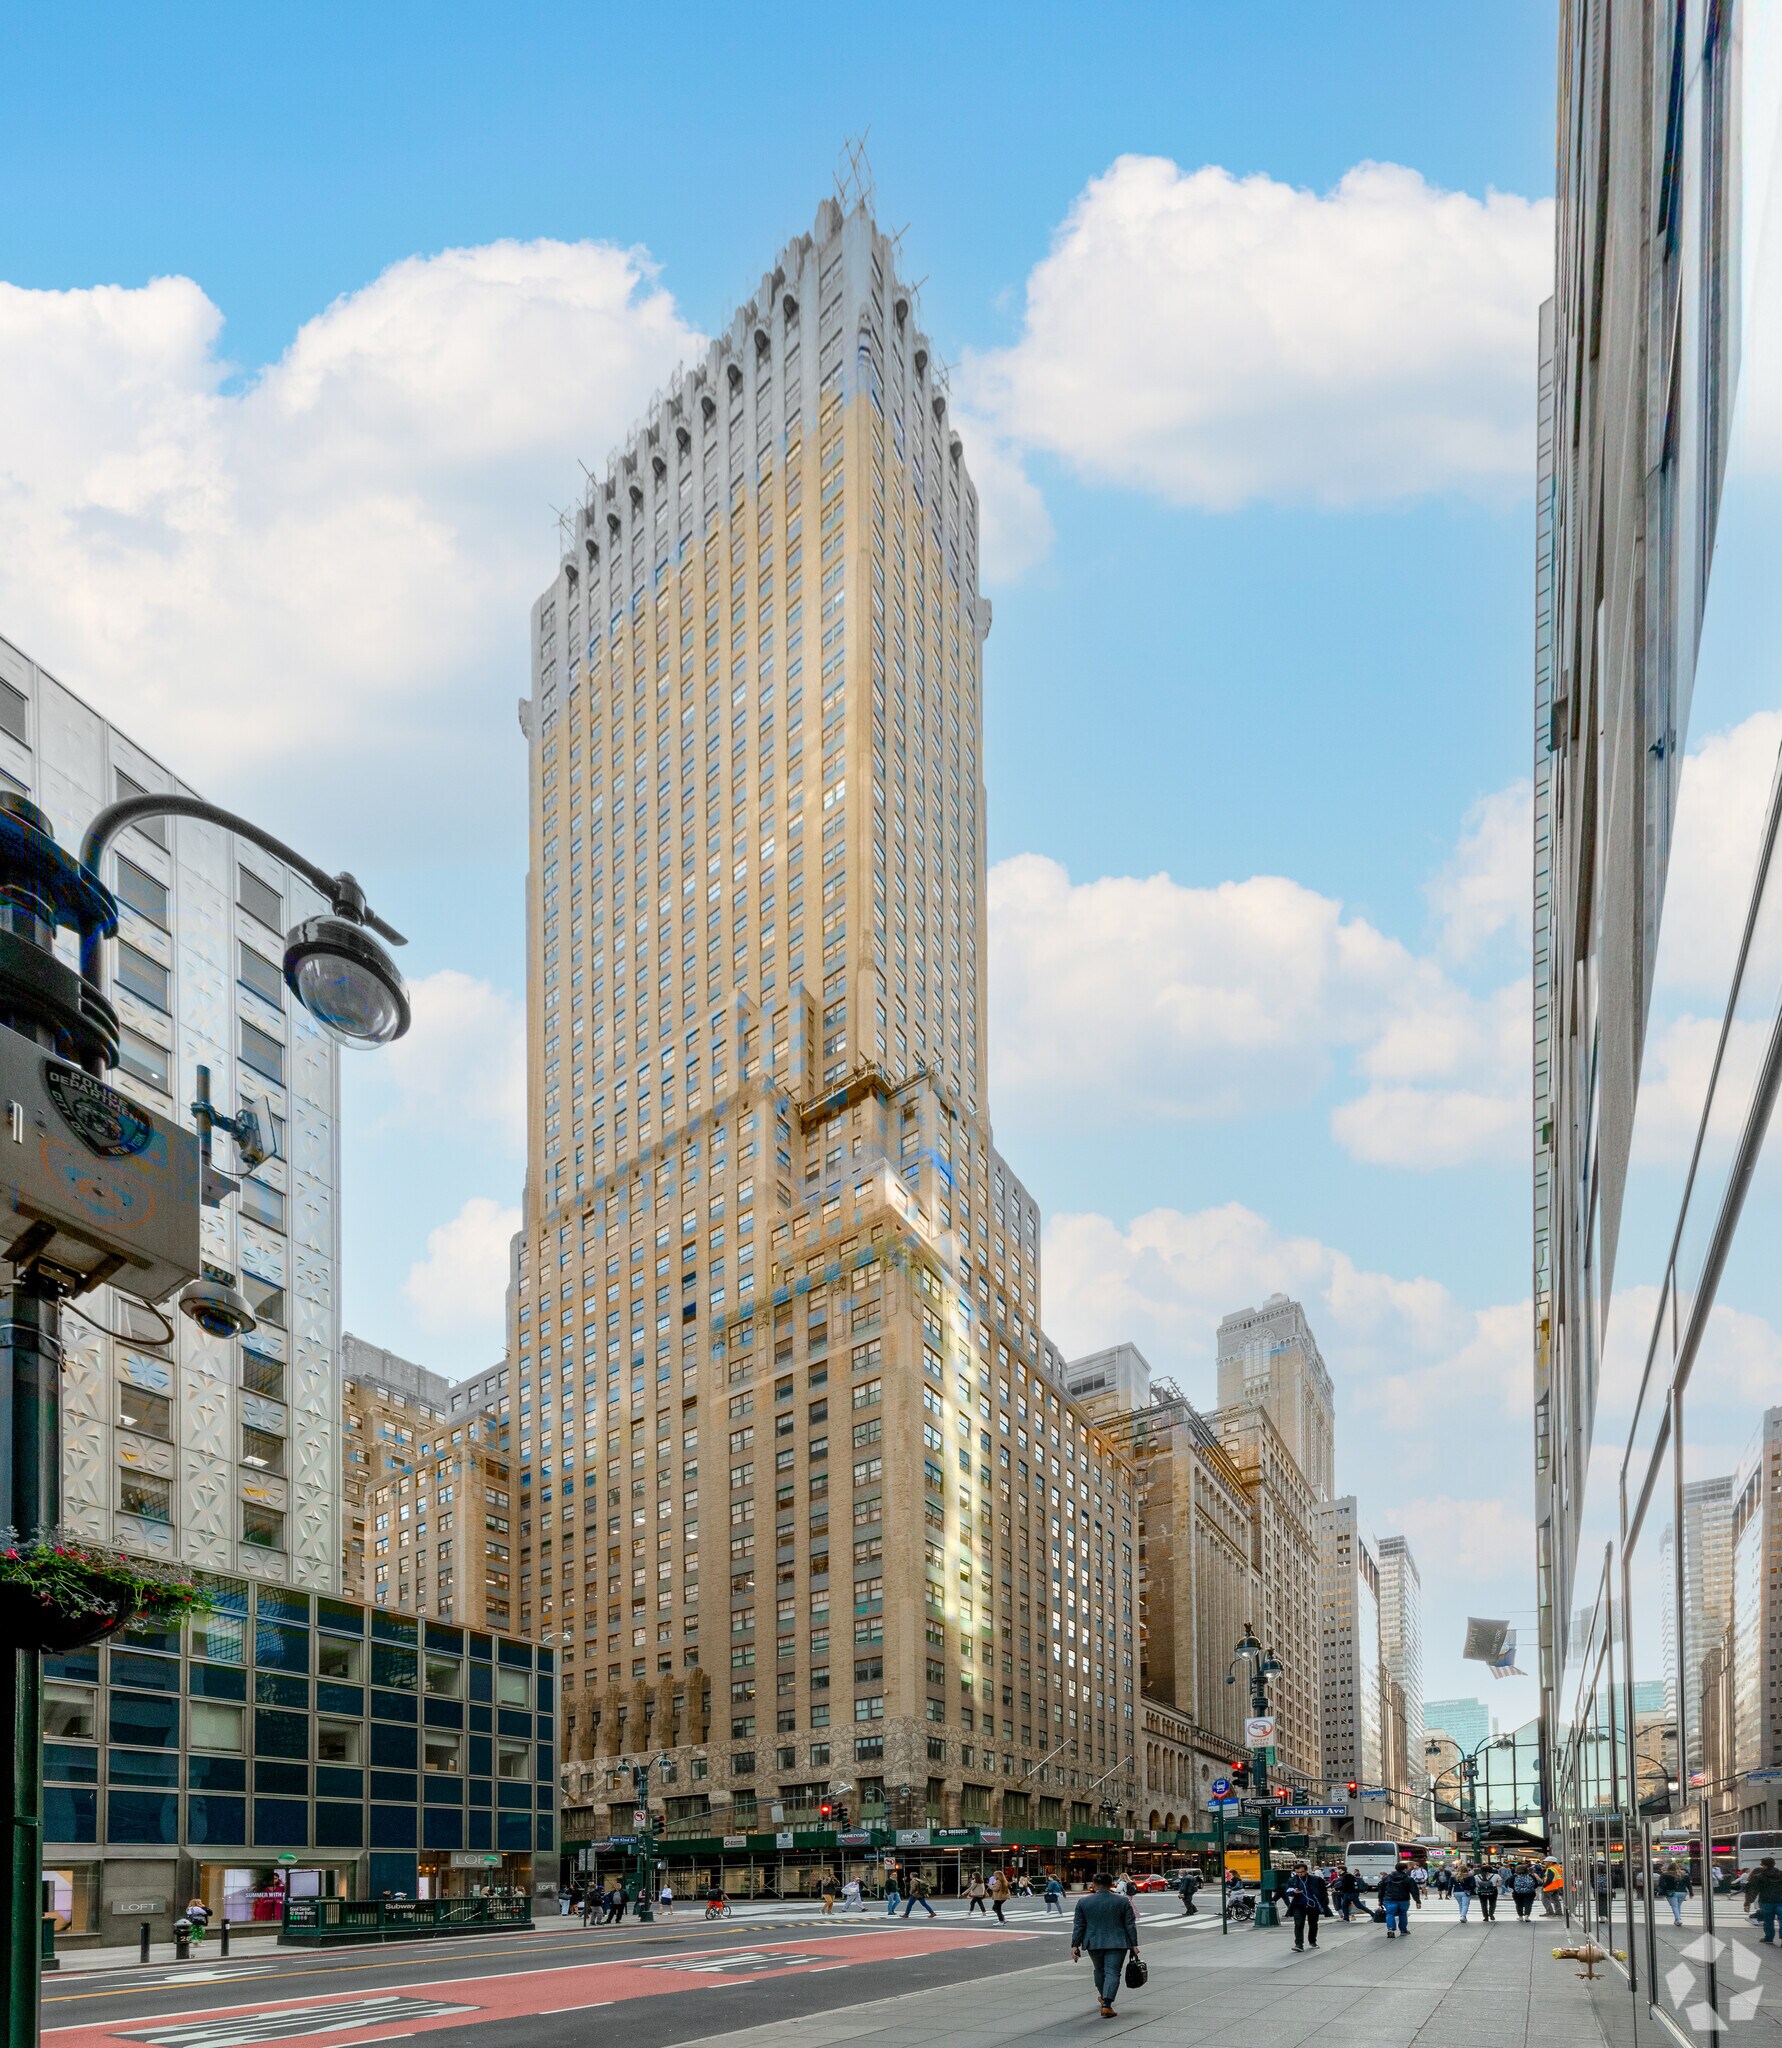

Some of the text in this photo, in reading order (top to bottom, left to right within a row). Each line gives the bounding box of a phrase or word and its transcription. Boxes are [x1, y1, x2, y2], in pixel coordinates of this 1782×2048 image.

[71, 1071, 128, 1106] POLICE
[49, 1071, 146, 1130] DEPARTMENT
[52, 1090, 88, 1137] CITY OF
[108, 1146, 129, 1155] NEW
[1277, 1807, 1325, 1815] Lexington
[456, 1855, 492, 1865] LOF
[121, 1903, 158, 1911] LOFT
